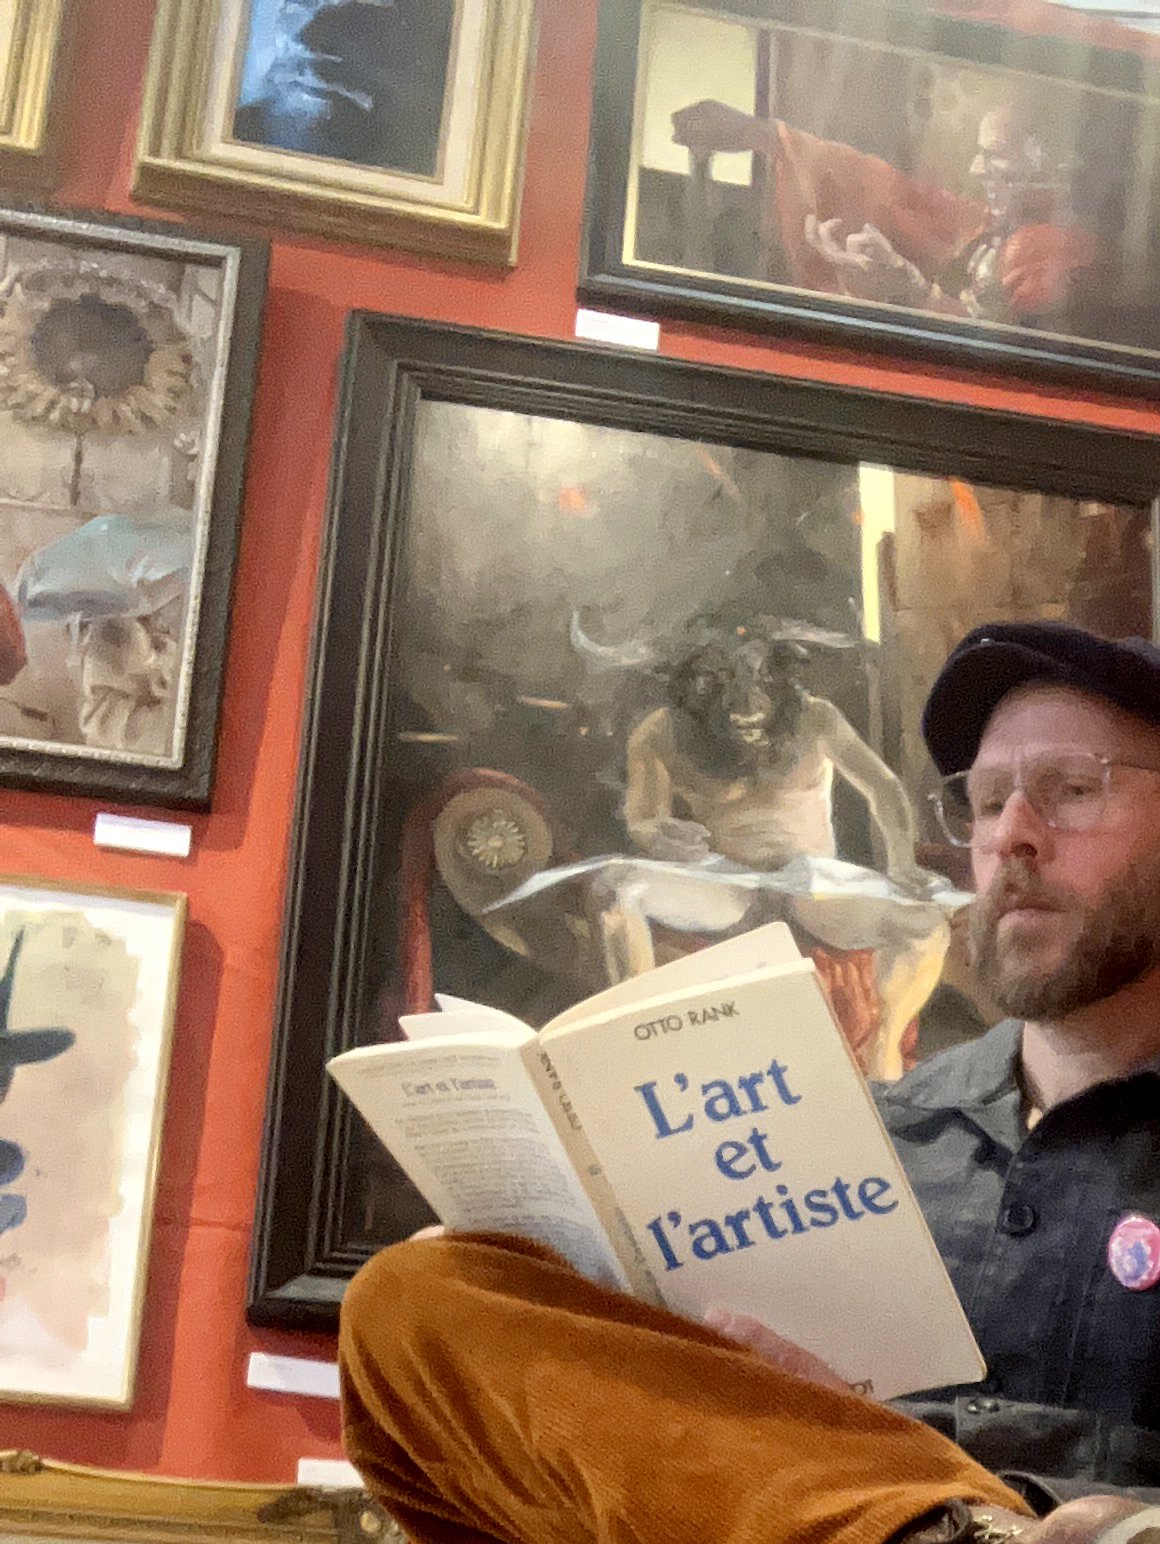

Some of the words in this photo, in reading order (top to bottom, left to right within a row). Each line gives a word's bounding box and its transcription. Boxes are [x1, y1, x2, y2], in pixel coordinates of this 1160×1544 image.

[633, 1014, 683, 1041] OTTO
[687, 1000, 741, 1026] RANK
[633, 1058, 803, 1140] L'art
[713, 1127, 783, 1180] et
[646, 1176, 899, 1272] l'artiste
